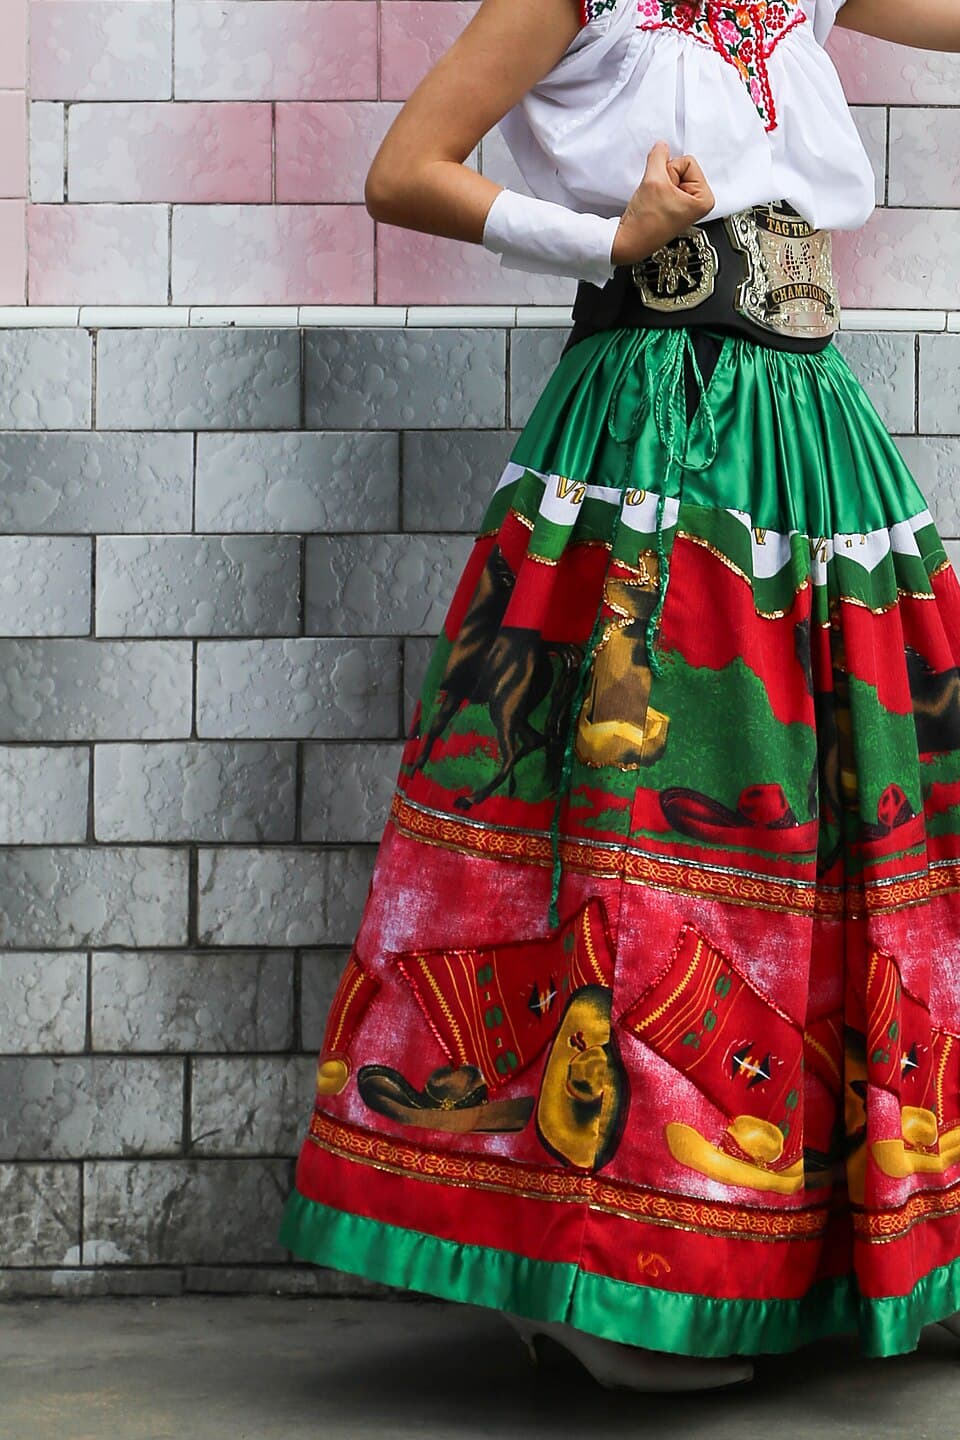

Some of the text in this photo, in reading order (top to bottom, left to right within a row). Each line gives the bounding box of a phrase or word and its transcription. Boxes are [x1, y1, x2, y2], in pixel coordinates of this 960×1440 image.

[766, 217, 812, 236] TAG TEA
[772, 285, 828, 304] CHAMPIONS
